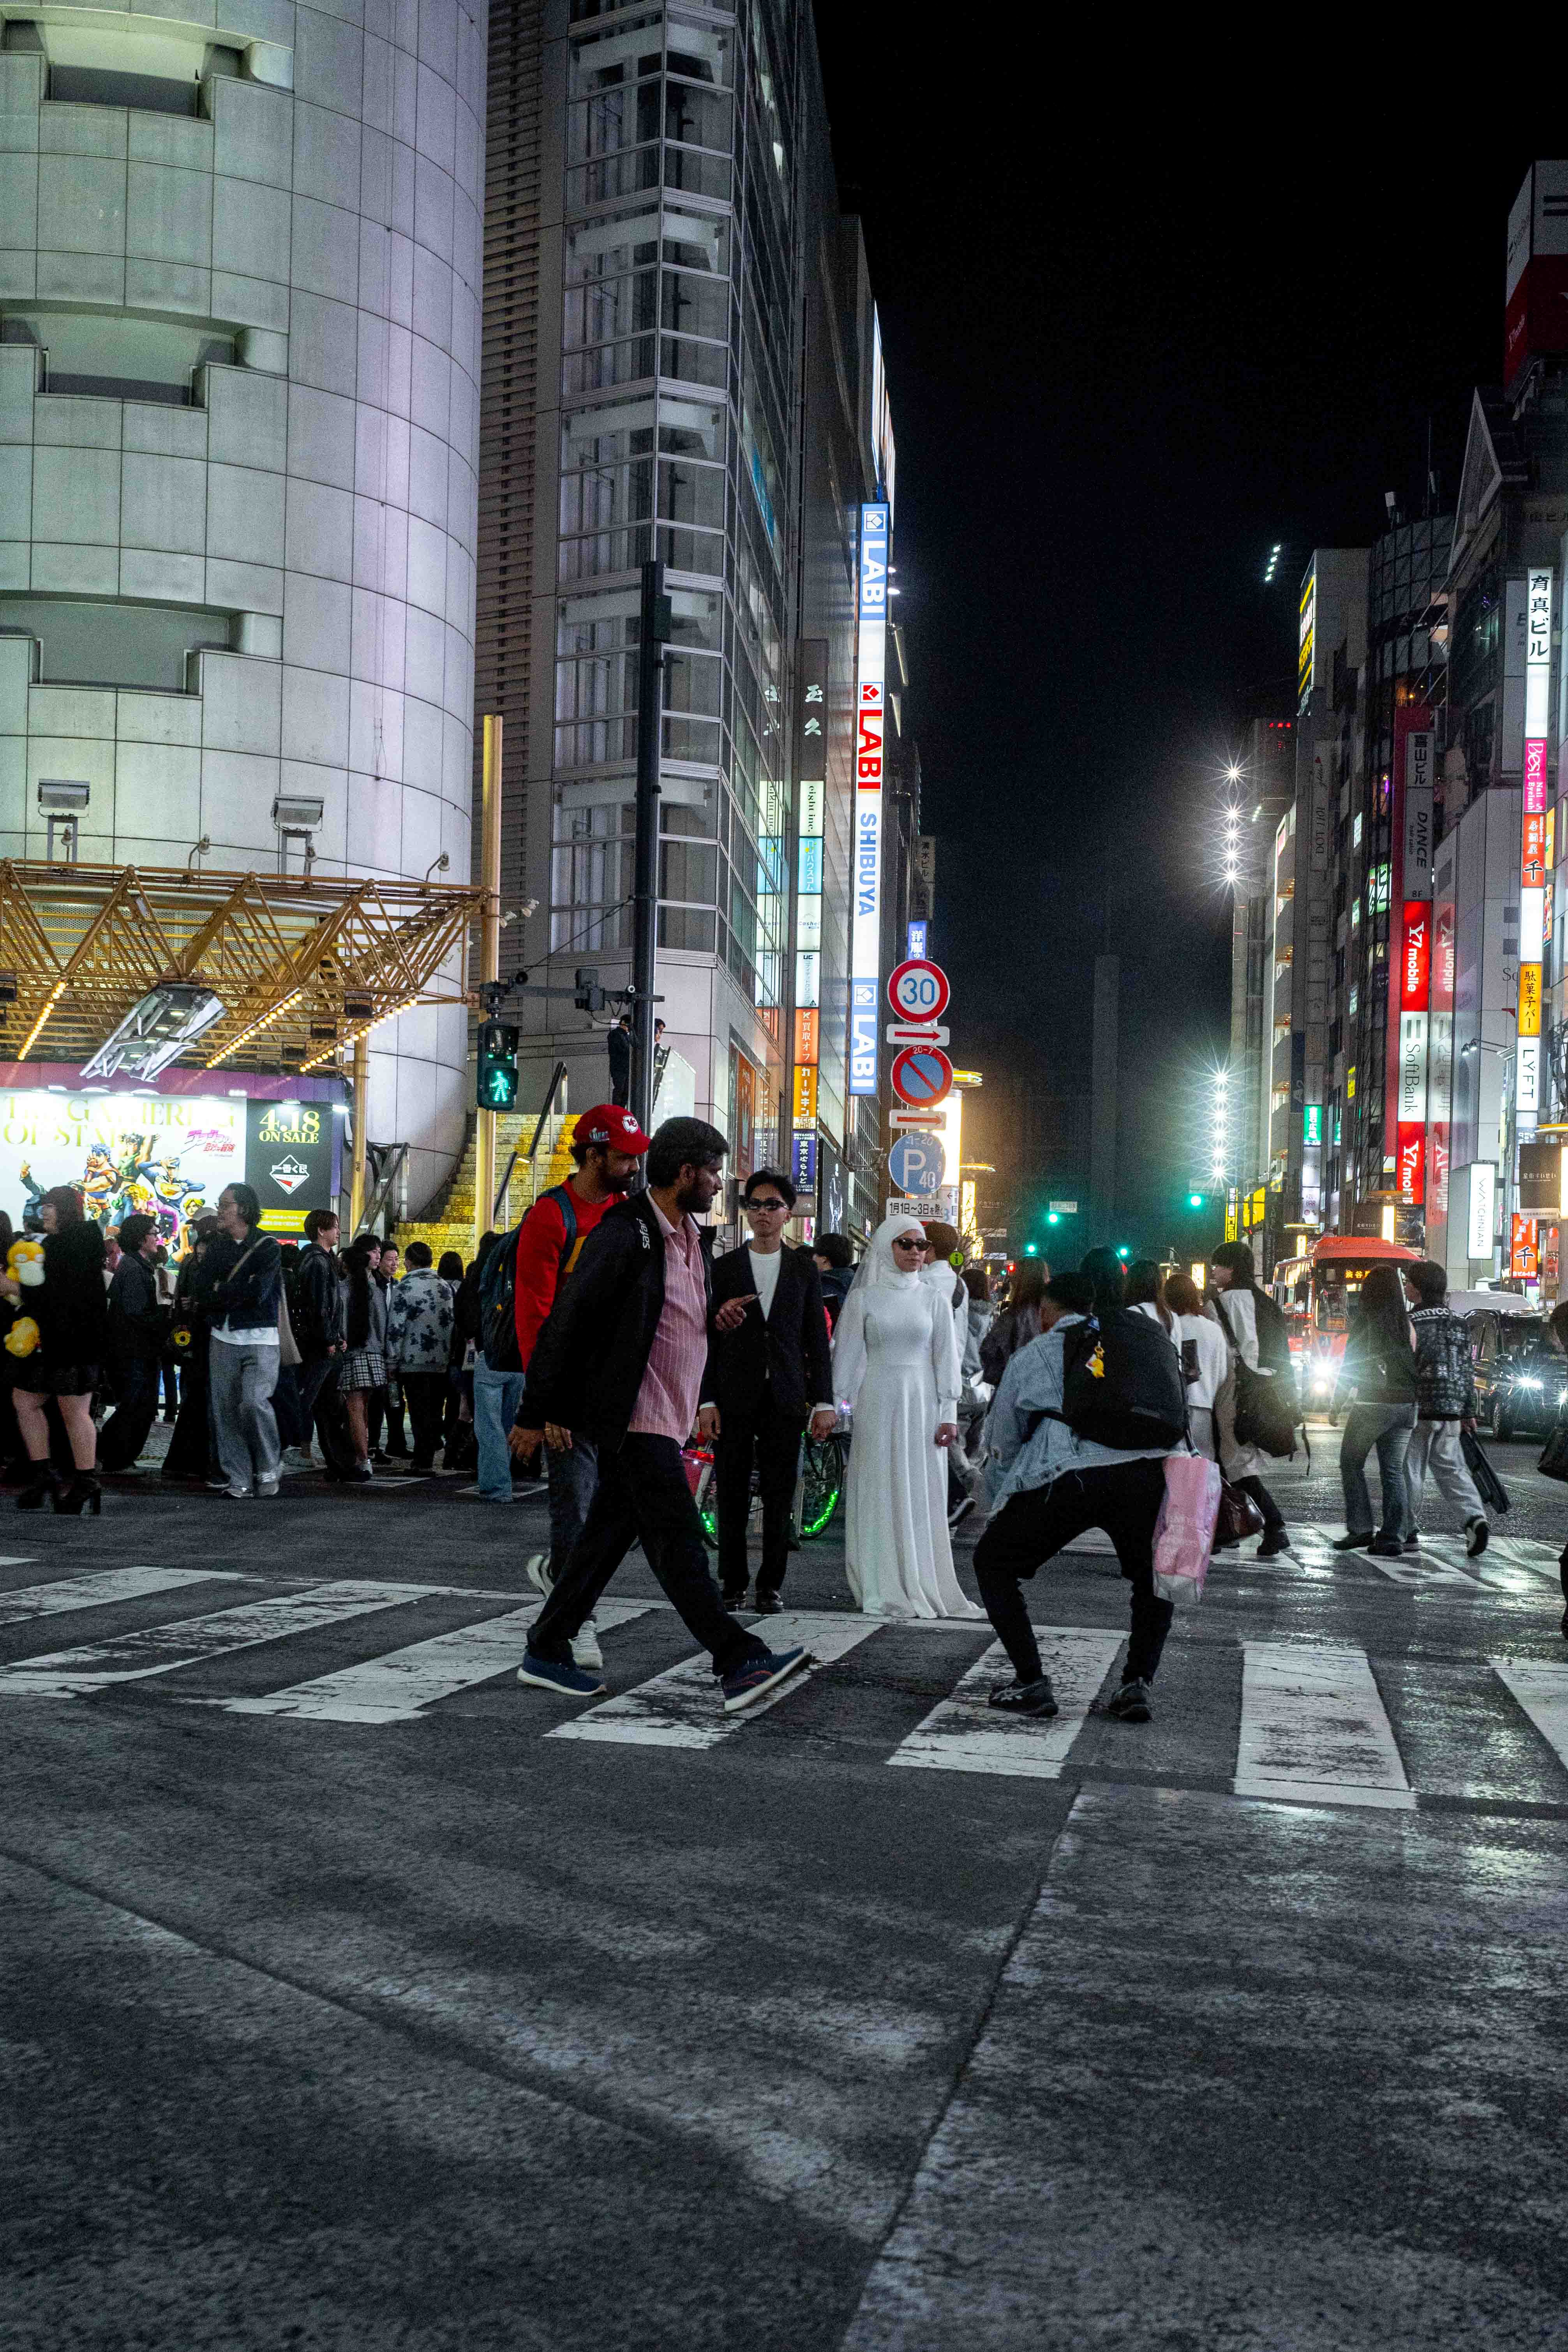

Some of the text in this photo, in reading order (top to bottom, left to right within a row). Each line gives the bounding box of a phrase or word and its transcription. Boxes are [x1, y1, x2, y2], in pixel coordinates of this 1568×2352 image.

[861, 541, 885, 614] LABI
[1531, 575, 1550, 656] 育真ビル
[804, 685, 823, 736] 玉久
[858, 709, 882, 790] LABI
[1527, 743, 1544, 780] Best
[808, 785, 816, 811] eight
[1417, 812, 1428, 868] DANCE
[859, 813, 877, 916] SHIBUYA
[1523, 859, 1543, 882] 千
[1407, 921, 1424, 992] Y! mobile
[903, 978, 935, 1005] 30
[1524, 971, 1536, 1029] 駄菓子バー
[802, 1022, 811, 1061] 買取オフ
[852, 1014, 876, 1087] LABI
[913, 1046, 934, 1054] 20-7
[1404, 1044, 1420, 1112] SoftBank
[1522, 1050, 1536, 1099] LYFT
[259, 1109, 320, 1133] 4.18
[259, 1131, 319, 1143] ON SALE
[1403, 1140, 1419, 1167] Y!
[919, 1171, 935, 1188] 40
[636, 1218, 650, 1249] safari
[1514, 1246, 1535, 1269] 千
